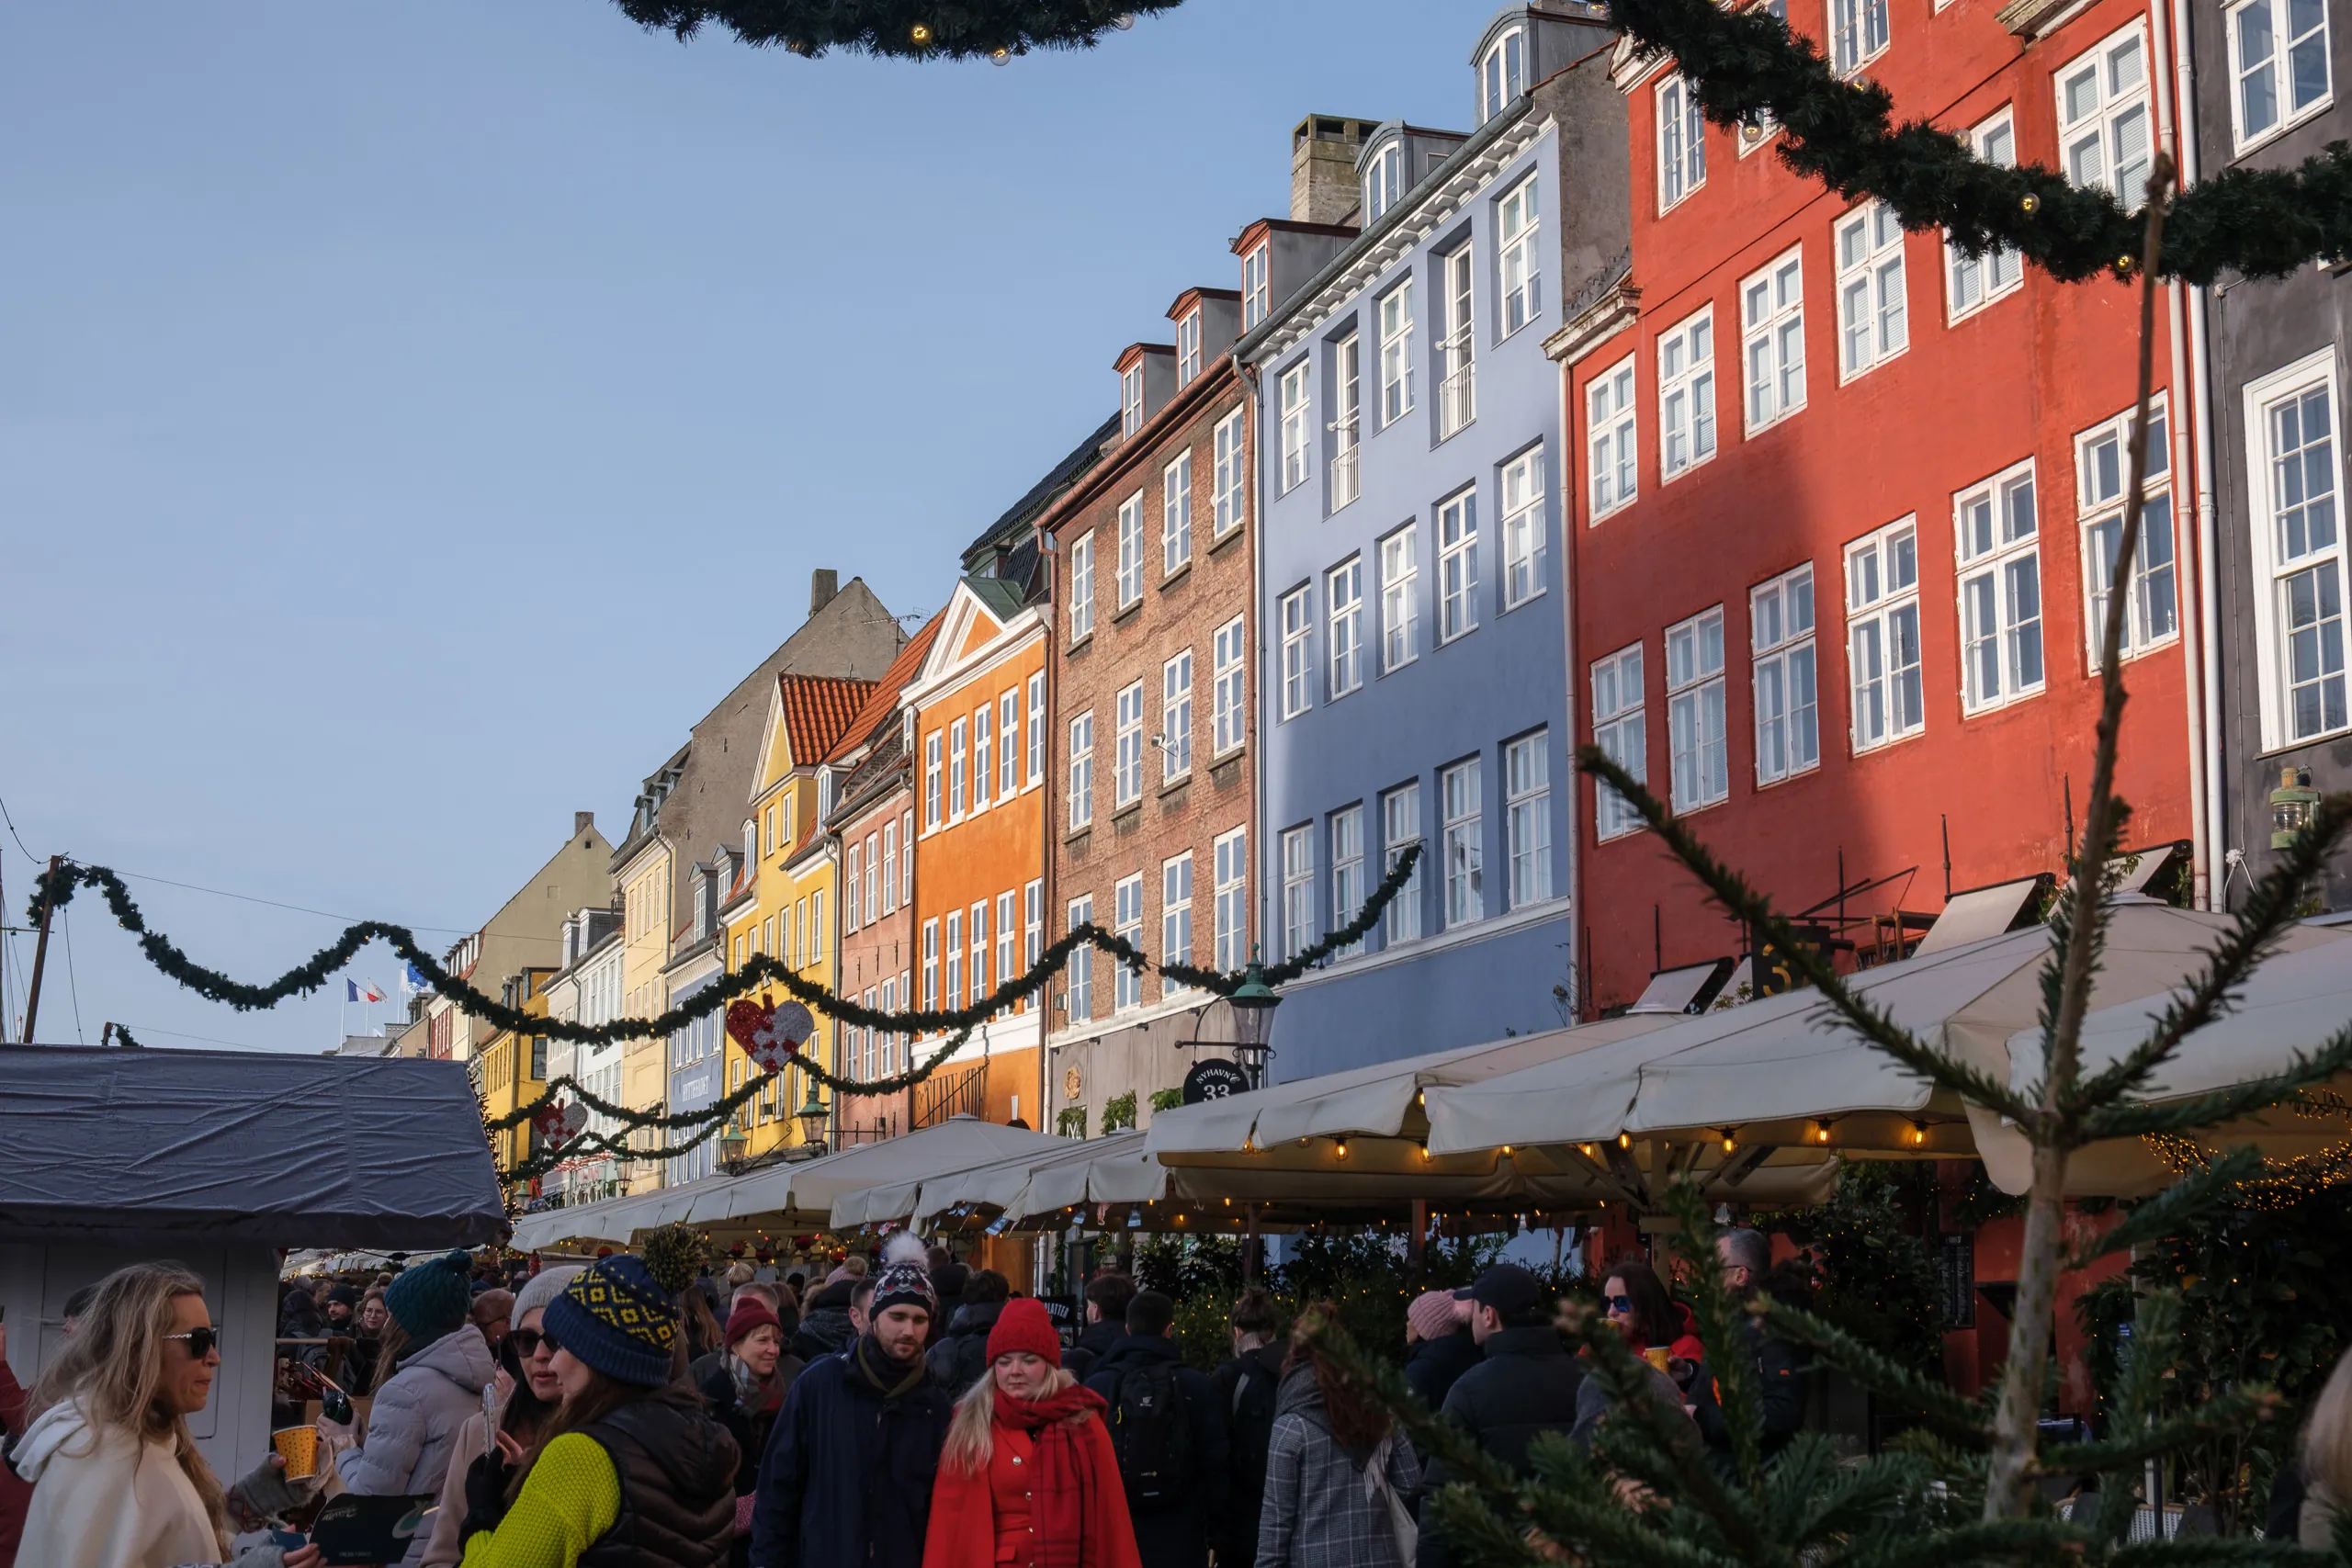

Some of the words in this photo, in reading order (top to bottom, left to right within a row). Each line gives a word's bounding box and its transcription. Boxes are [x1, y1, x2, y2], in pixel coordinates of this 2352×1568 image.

[1195, 1068, 1231, 1084] NYHAVN
[1204, 1084, 1230, 1102] 33
[1044, 1302, 1069, 1319] PLATTER
